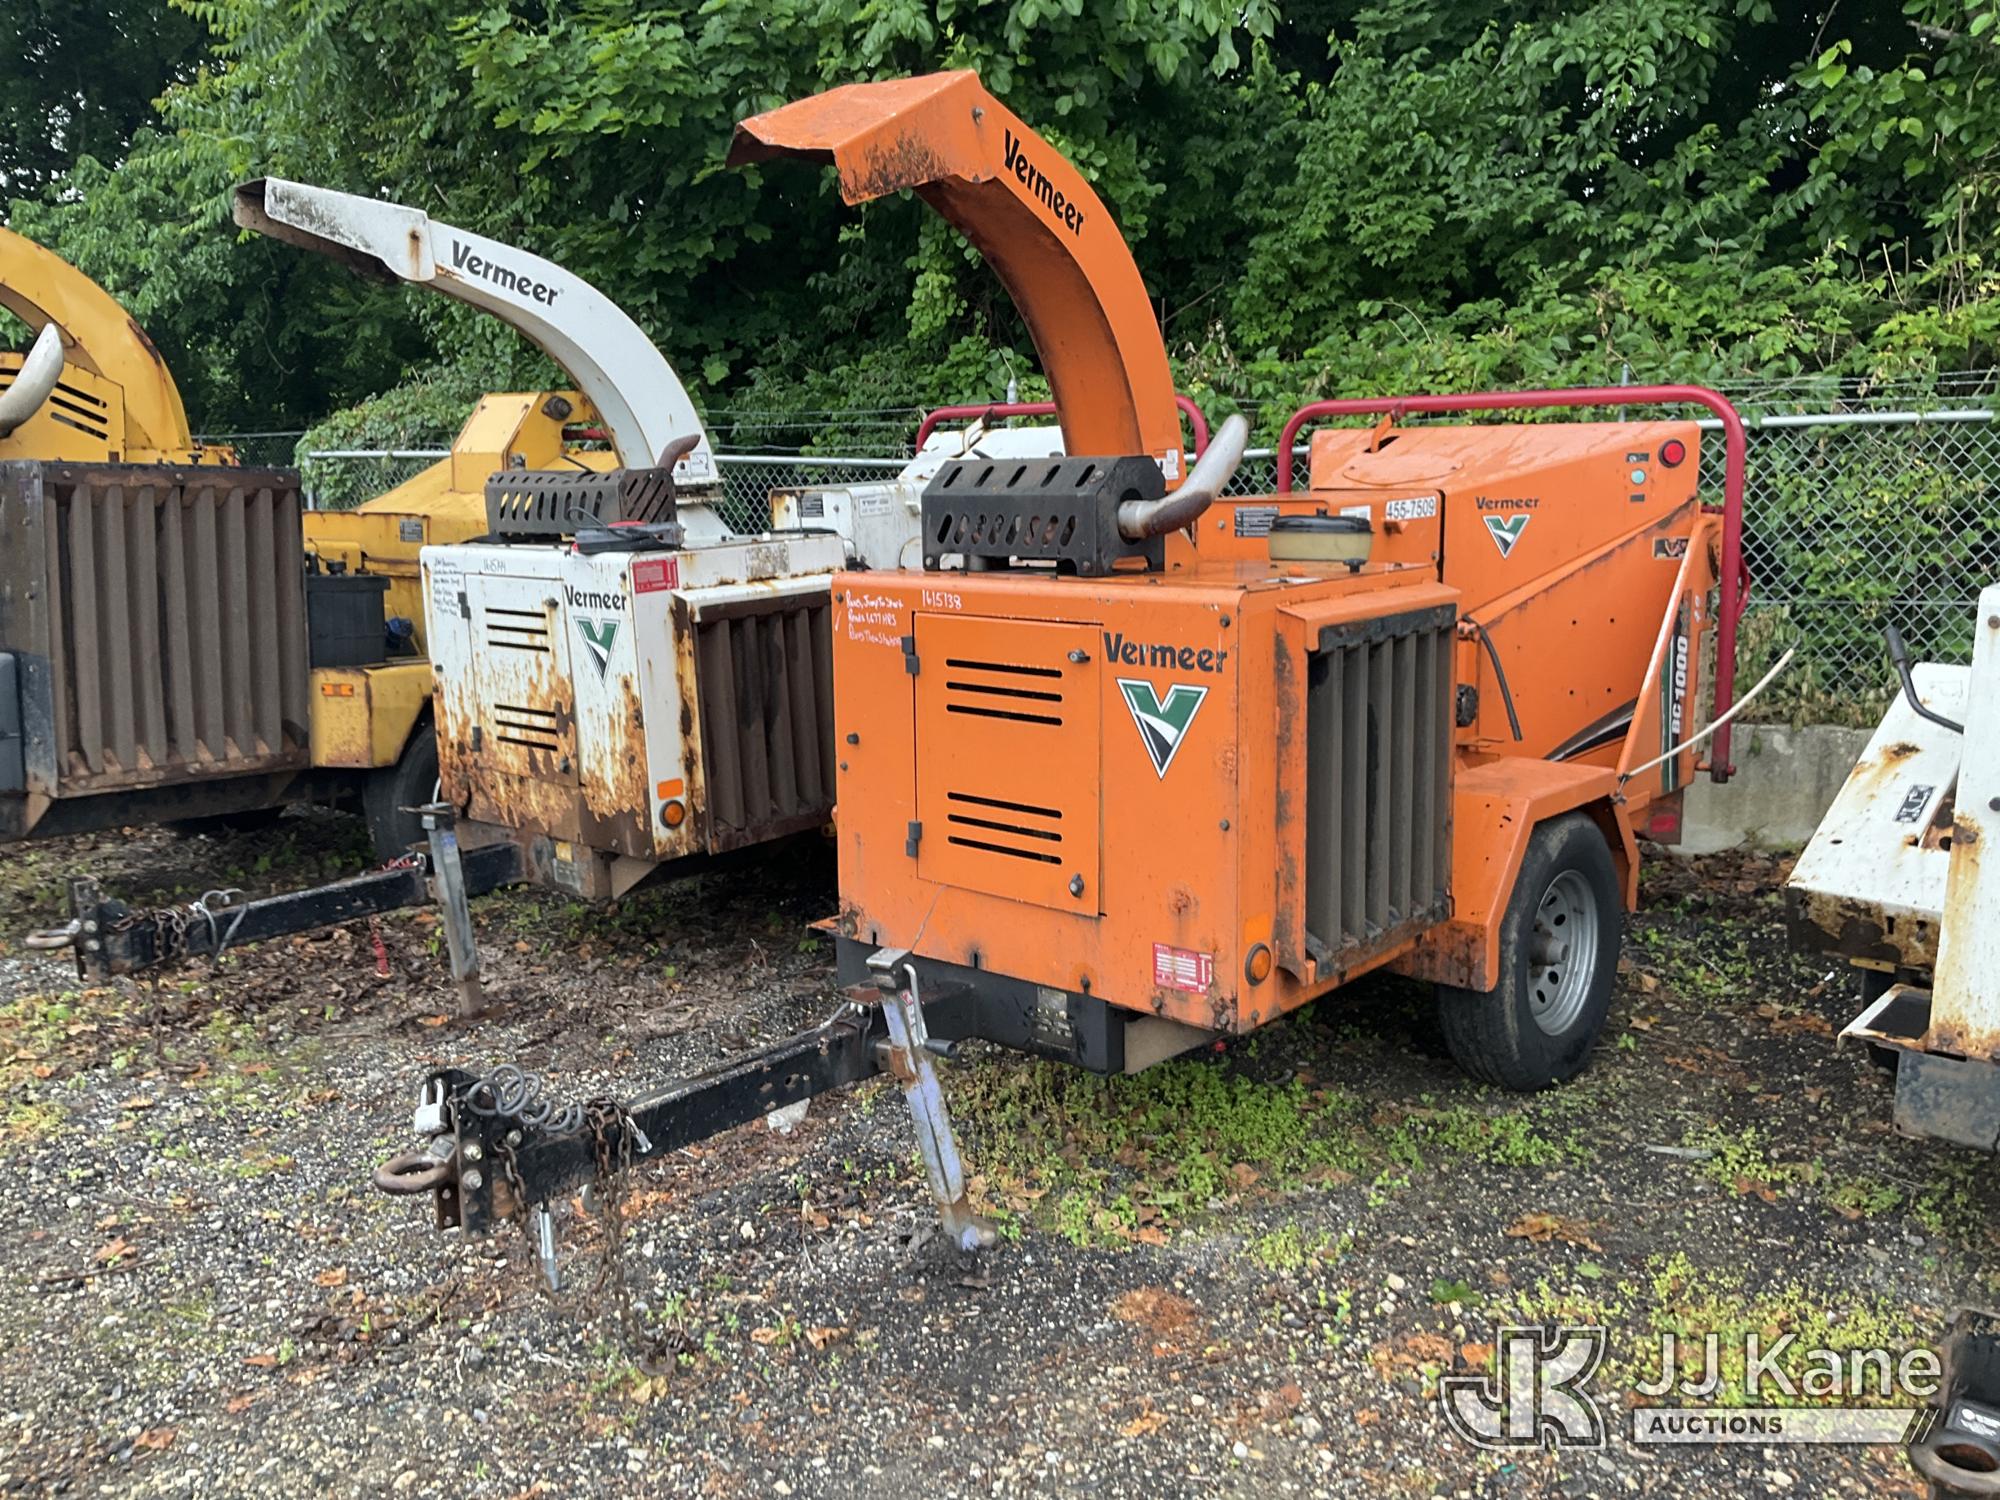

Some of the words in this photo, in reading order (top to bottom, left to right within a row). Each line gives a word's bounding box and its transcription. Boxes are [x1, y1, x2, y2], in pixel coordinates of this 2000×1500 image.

[1005, 128, 1083, 236] Vermeer
[453, 239, 558, 306] Vermeer
[1386, 498, 1434, 519] 455-7509
[1475, 496, 1540, 510] Vermeer
[564, 584, 627, 611] Vermeer
[922, 589, 962, 610] 1615138
[1103, 632, 1227, 674] Vermeer
